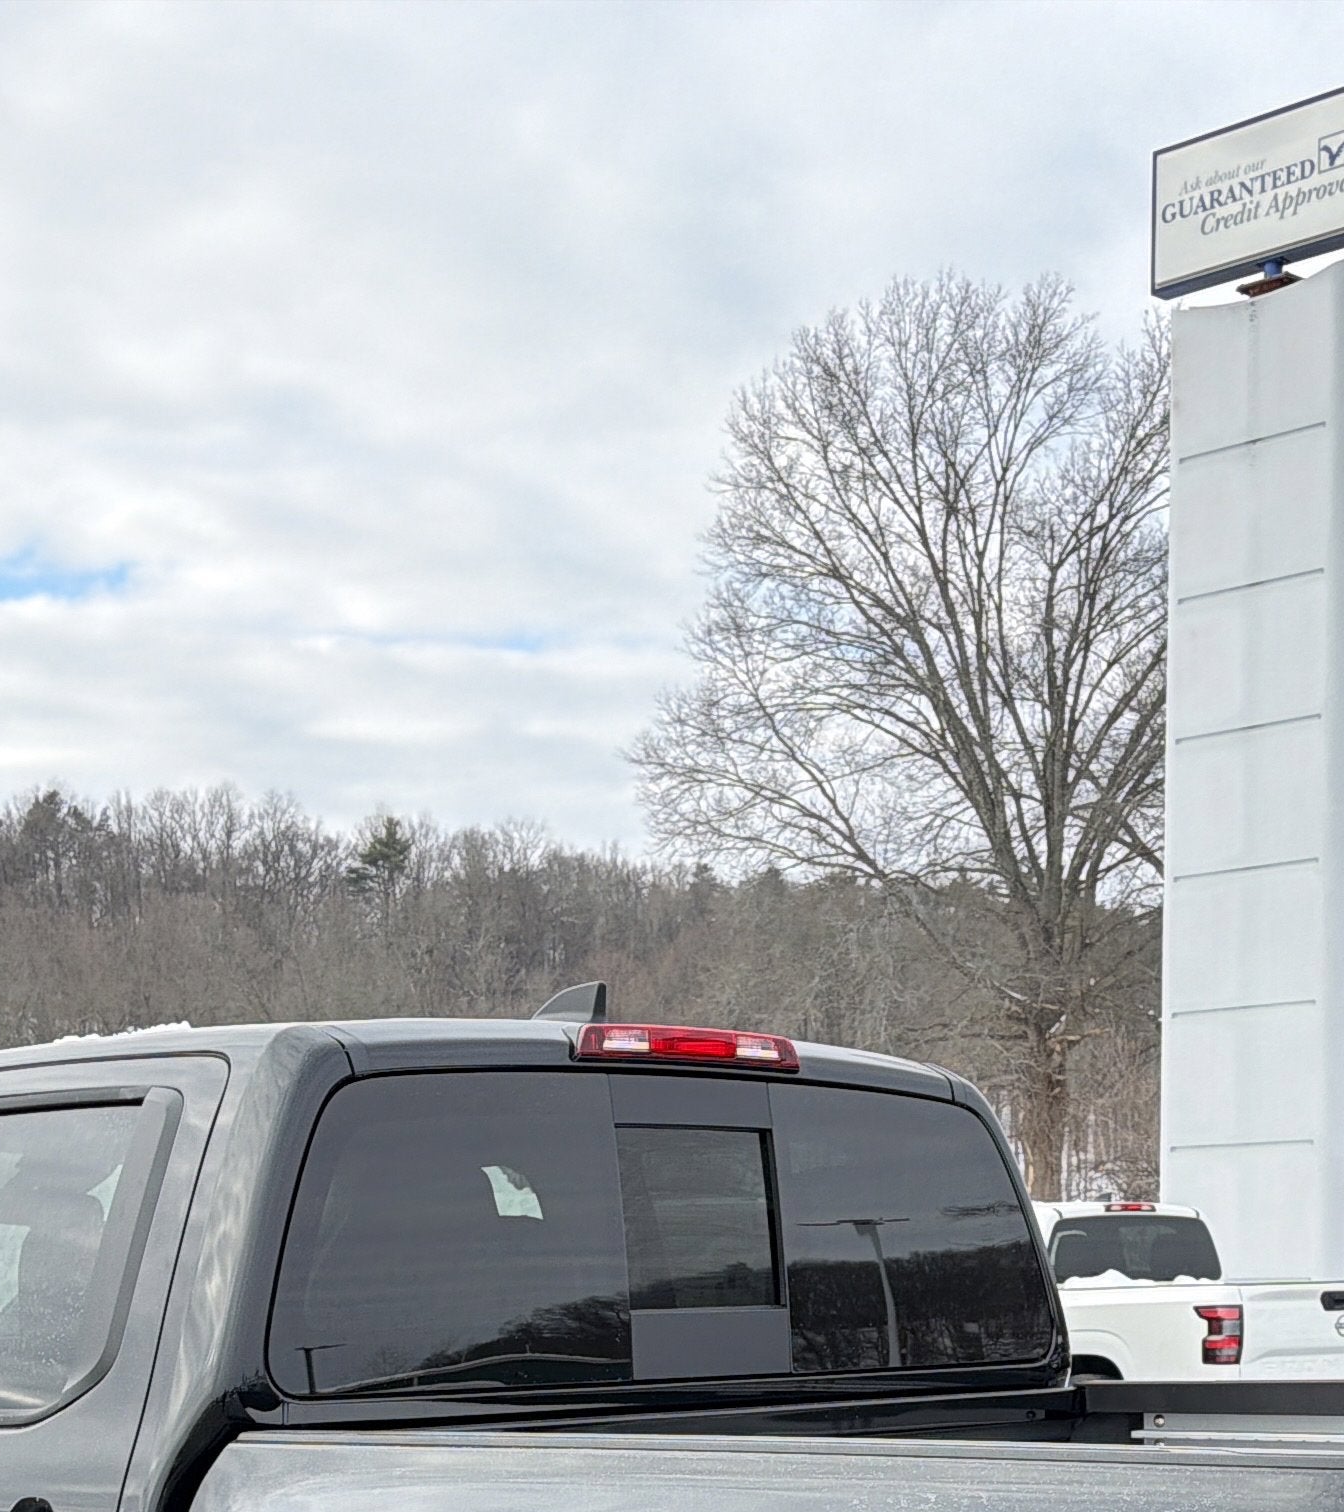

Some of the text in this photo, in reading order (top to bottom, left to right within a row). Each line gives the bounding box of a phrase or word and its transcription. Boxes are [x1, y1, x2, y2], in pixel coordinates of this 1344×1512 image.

[1161, 158, 1316, 223] GUARANTEED
[1179, 159, 1267, 196] Ask about our
[1201, 200, 1260, 235] Credit
